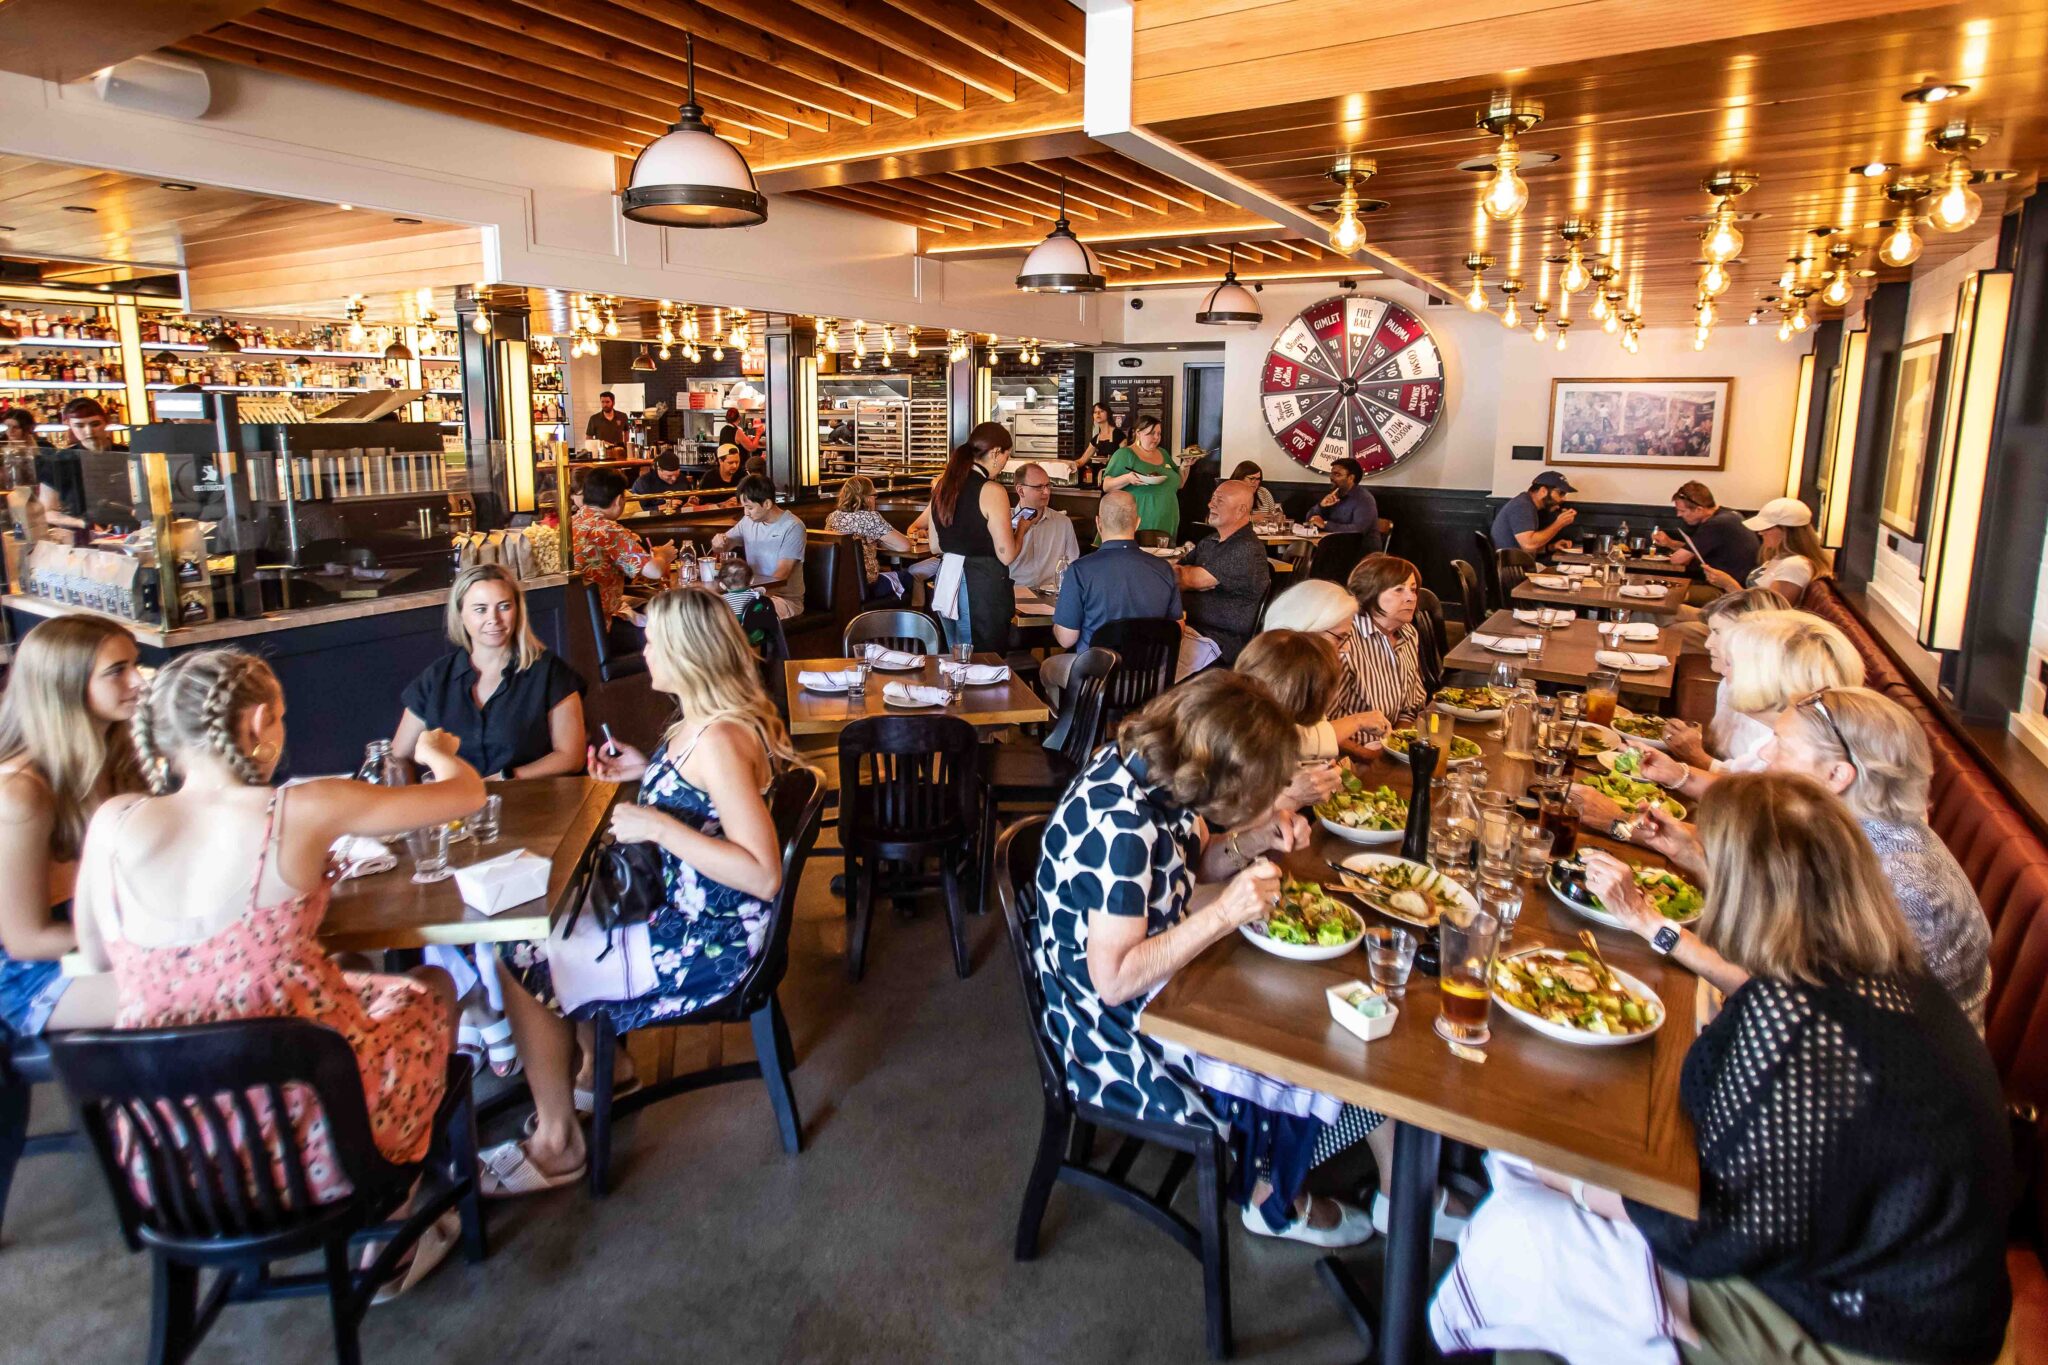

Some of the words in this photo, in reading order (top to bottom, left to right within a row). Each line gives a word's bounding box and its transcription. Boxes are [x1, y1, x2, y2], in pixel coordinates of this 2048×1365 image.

[1313, 312, 1341, 330] GIMLET
[1356, 306, 1373, 318] FIRE
[1353, 317, 1371, 329] BALL
[1385, 318, 1410, 342] PALOMA
[1297, 341, 1309, 353] B
[1406, 348, 1422, 375] COSMO
[1272, 366, 1283, 383] TOM
[1280, 365, 1294, 387] Collins
[1407, 385, 1420, 411] SINATRA
[1281, 399, 1294, 418] SHOT
[1292, 425, 1315, 447] Fashioned
[1385, 419, 1402, 437] MULE
[1390, 423, 1411, 445] MOSCOW
[1292, 436, 1305, 449] OLD
[1324, 443, 1343, 455] SOUR
